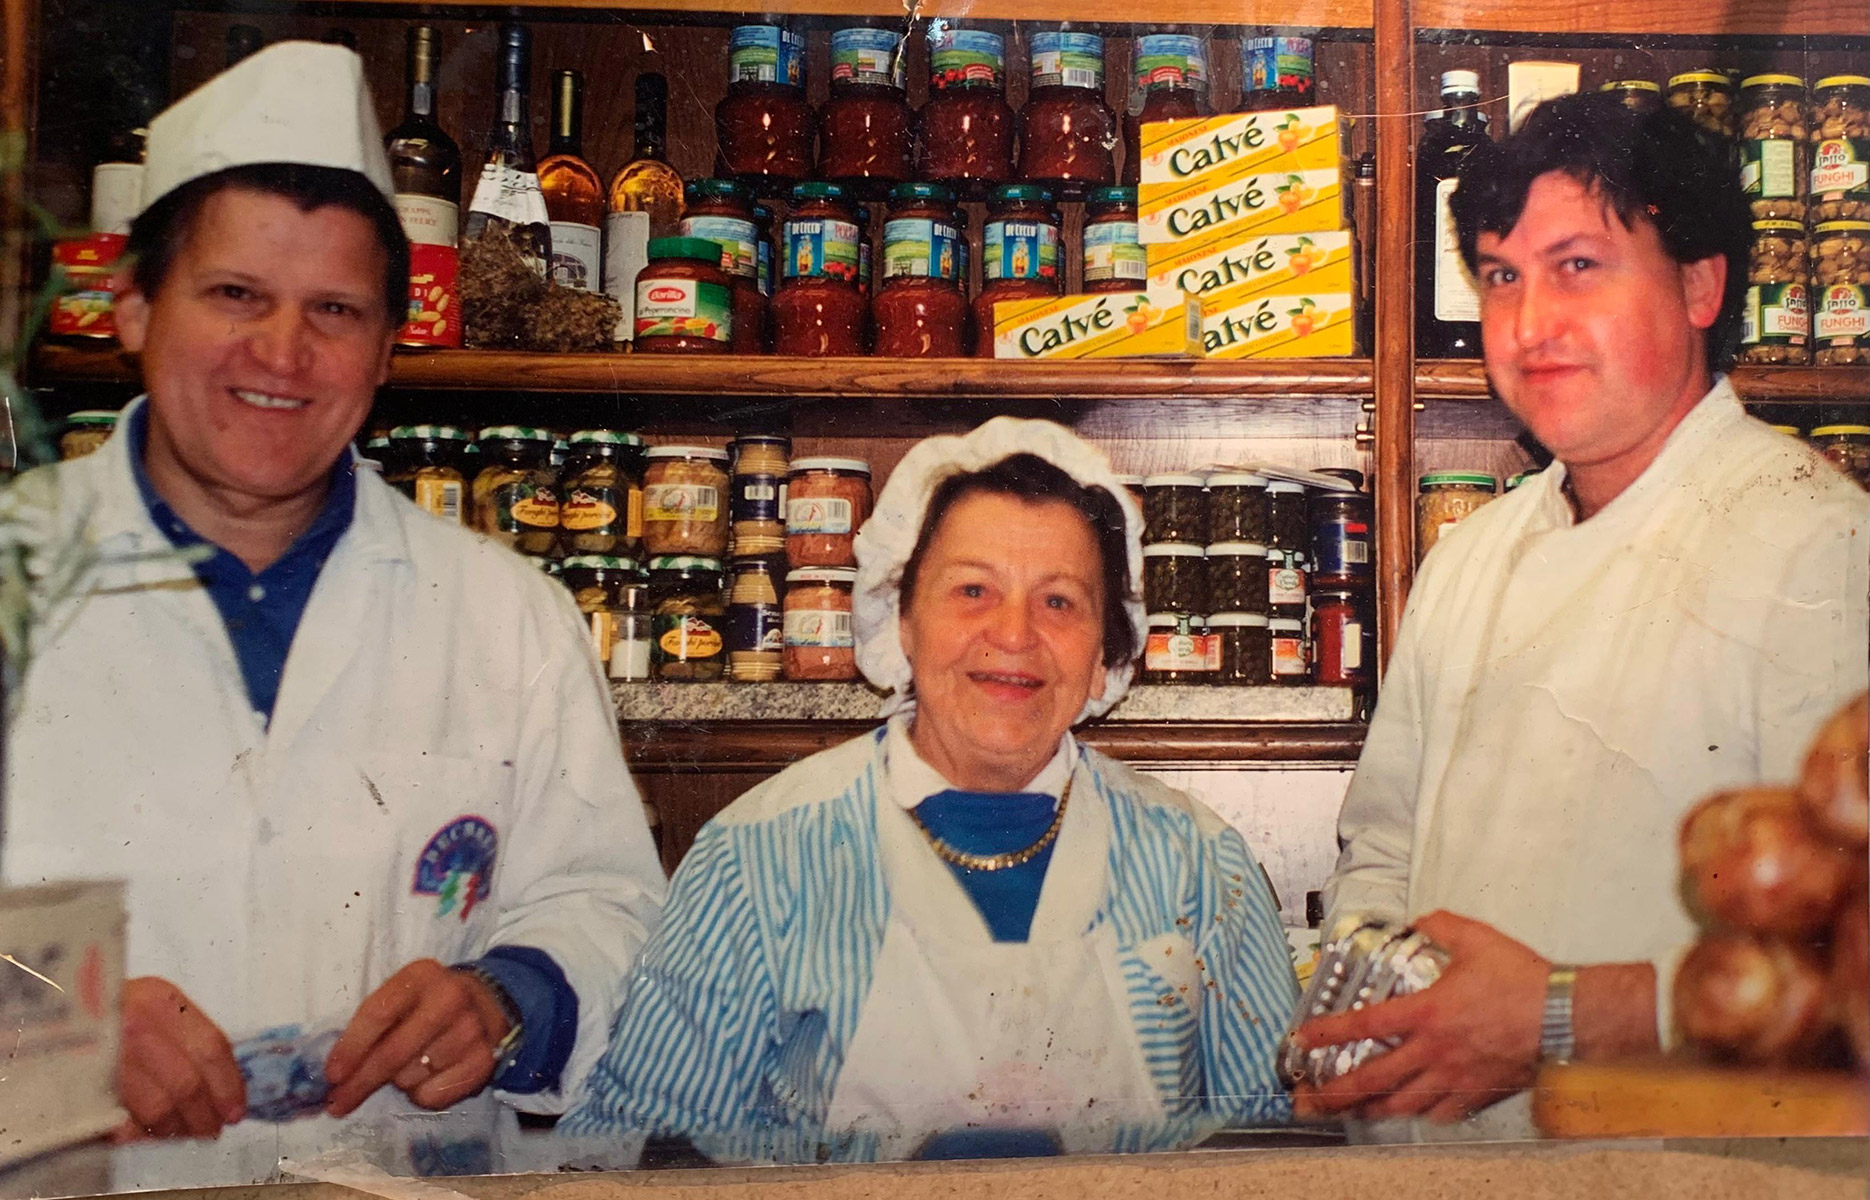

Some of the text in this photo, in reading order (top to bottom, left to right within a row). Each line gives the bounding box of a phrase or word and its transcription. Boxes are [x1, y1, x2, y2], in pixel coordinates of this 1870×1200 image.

[1168, 116, 1265, 177] Calvé
[1814, 169, 1855, 185] FUNGHI
[1167, 177, 1265, 238] Calvé
[1015, 223, 1037, 237] CECCO
[1175, 246, 1219, 267] MAIONESE
[1177, 239, 1276, 295] Calvé
[650, 289, 685, 301] Barilla
[1019, 297, 1114, 357] Calvé
[1203, 299, 1278, 352] alvé
[1820, 317, 1865, 328] FUNGHI
